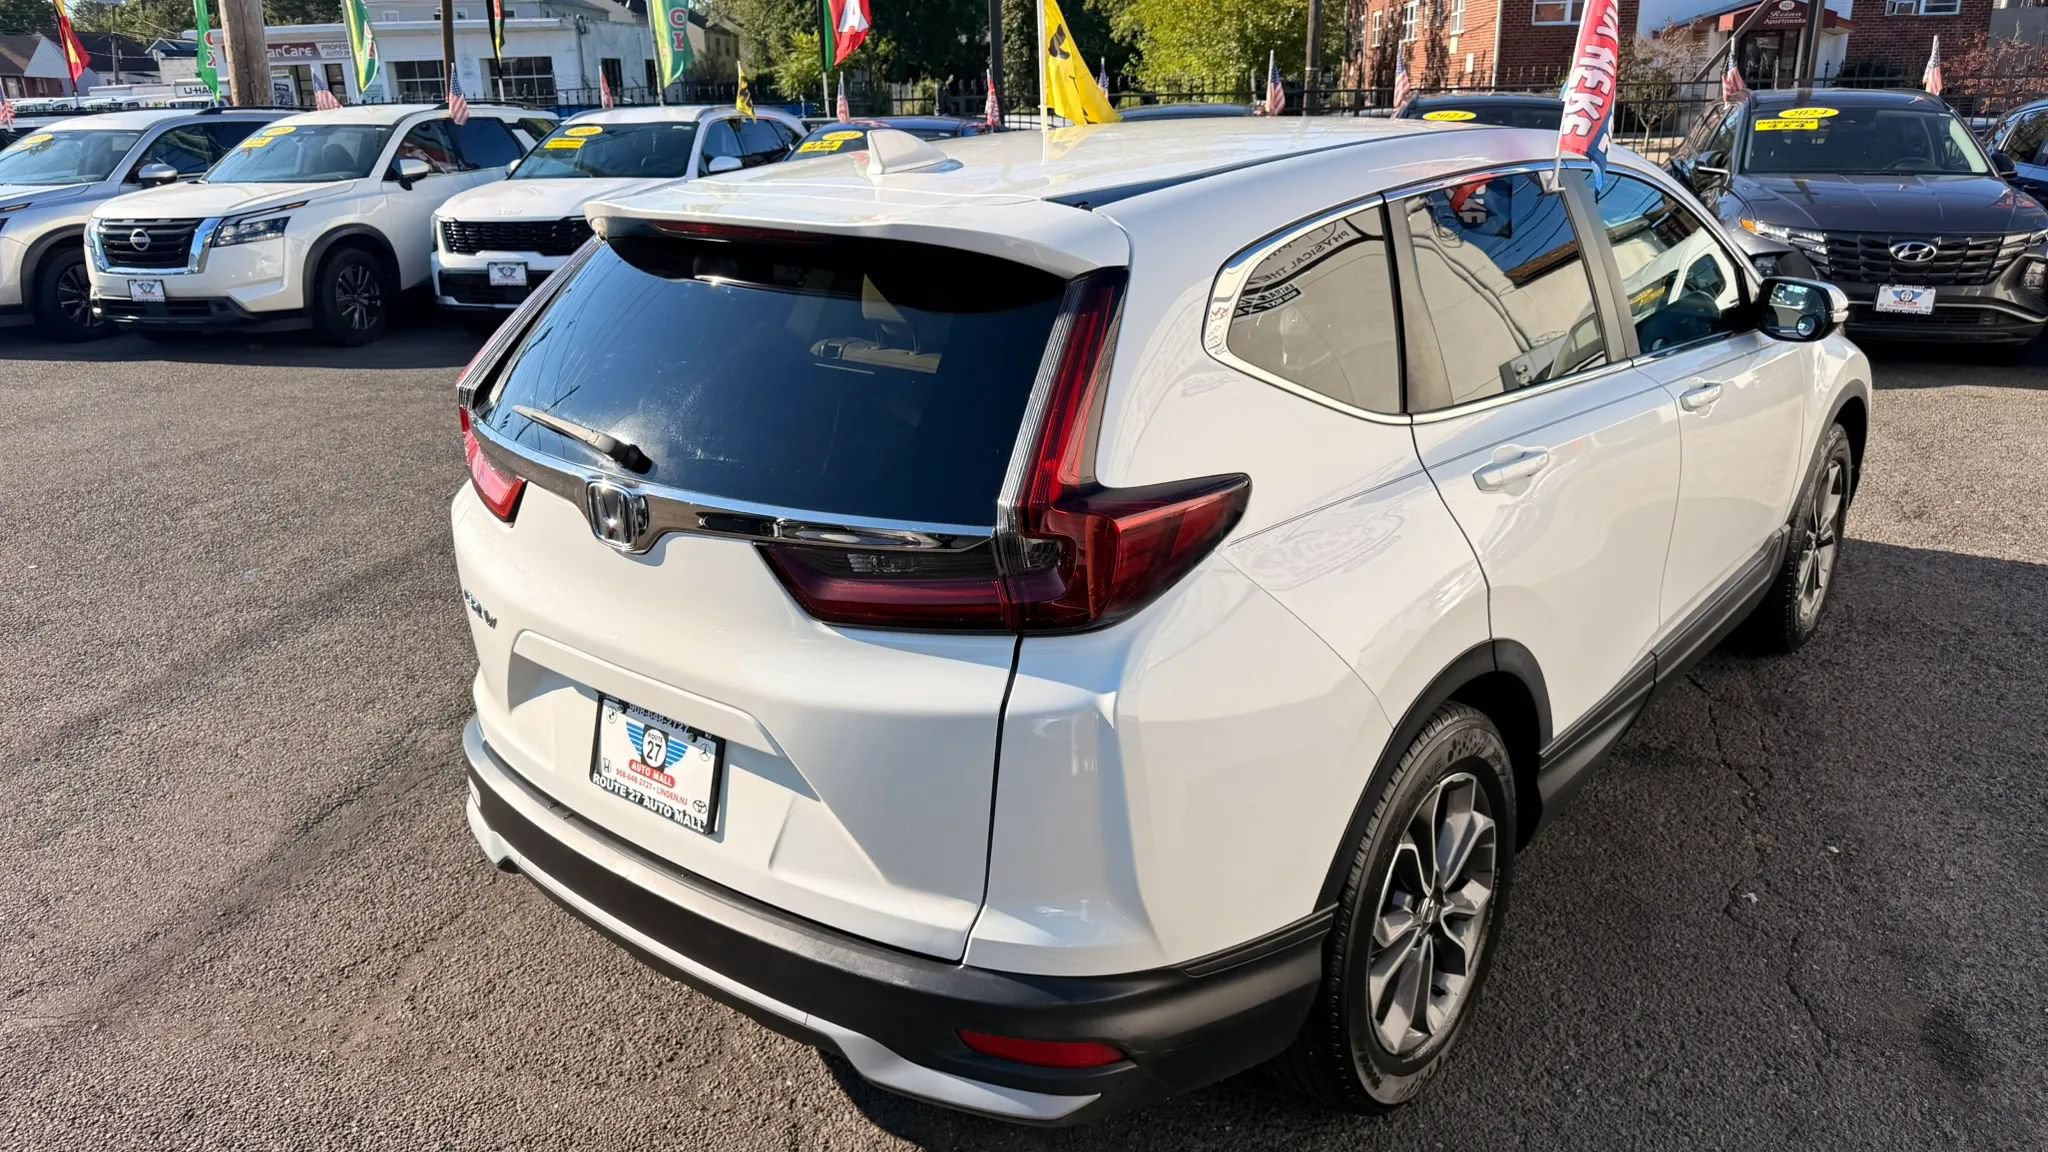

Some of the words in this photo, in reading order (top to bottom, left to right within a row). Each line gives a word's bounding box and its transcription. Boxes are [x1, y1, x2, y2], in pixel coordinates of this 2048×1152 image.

[266, 45, 313, 58] arCare
[183, 86, 222, 95] U-HA
[648, 731, 663, 743] ROUTE
[646, 740, 662, 762] 27
[631, 761, 651, 776] AUTO
[652, 769, 673, 786] MALL
[593, 773, 626, 797] ROUTE
[628, 789, 642, 803] 27
[643, 796, 672, 816] AUTO
[675, 808, 704, 833] MALL
